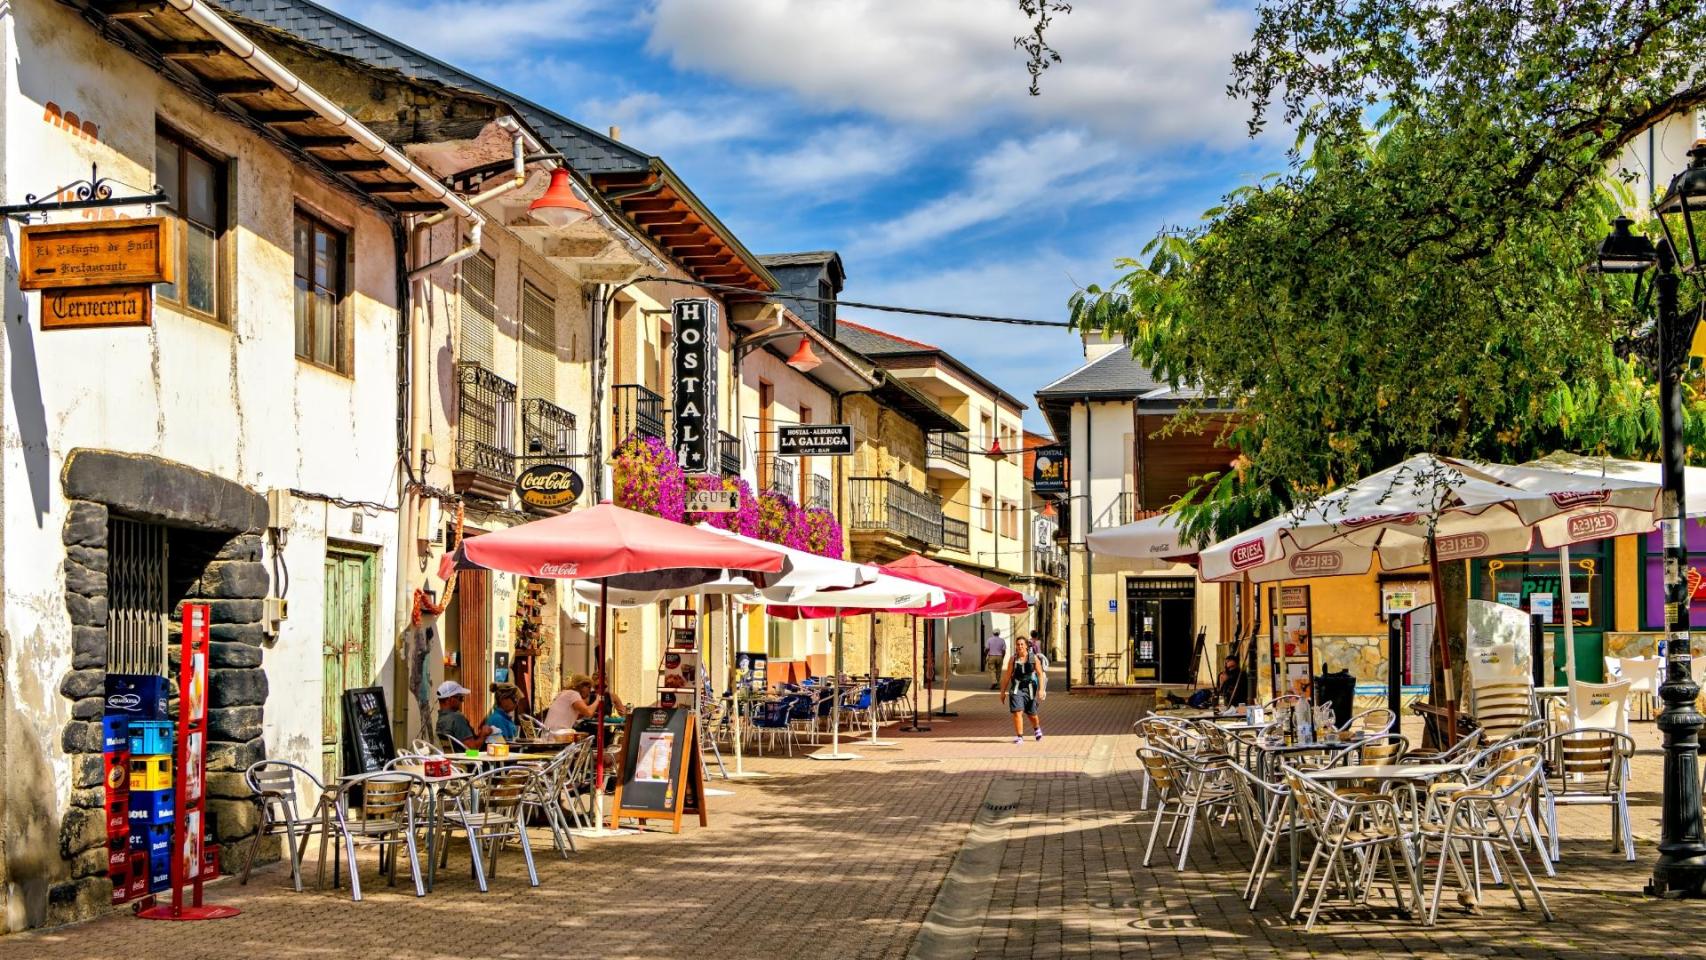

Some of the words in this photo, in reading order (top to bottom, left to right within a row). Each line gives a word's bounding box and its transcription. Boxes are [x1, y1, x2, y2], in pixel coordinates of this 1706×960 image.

[107, 241, 119, 251] de
[60, 262, 128, 274] Restaurante
[52, 292, 137, 319] Cervecería
[680, 304, 701, 442] HOSTAL
[781, 438, 796, 446] LA
[799, 436, 849, 446] GALLEGA
[1522, 580, 1560, 598] Pili
